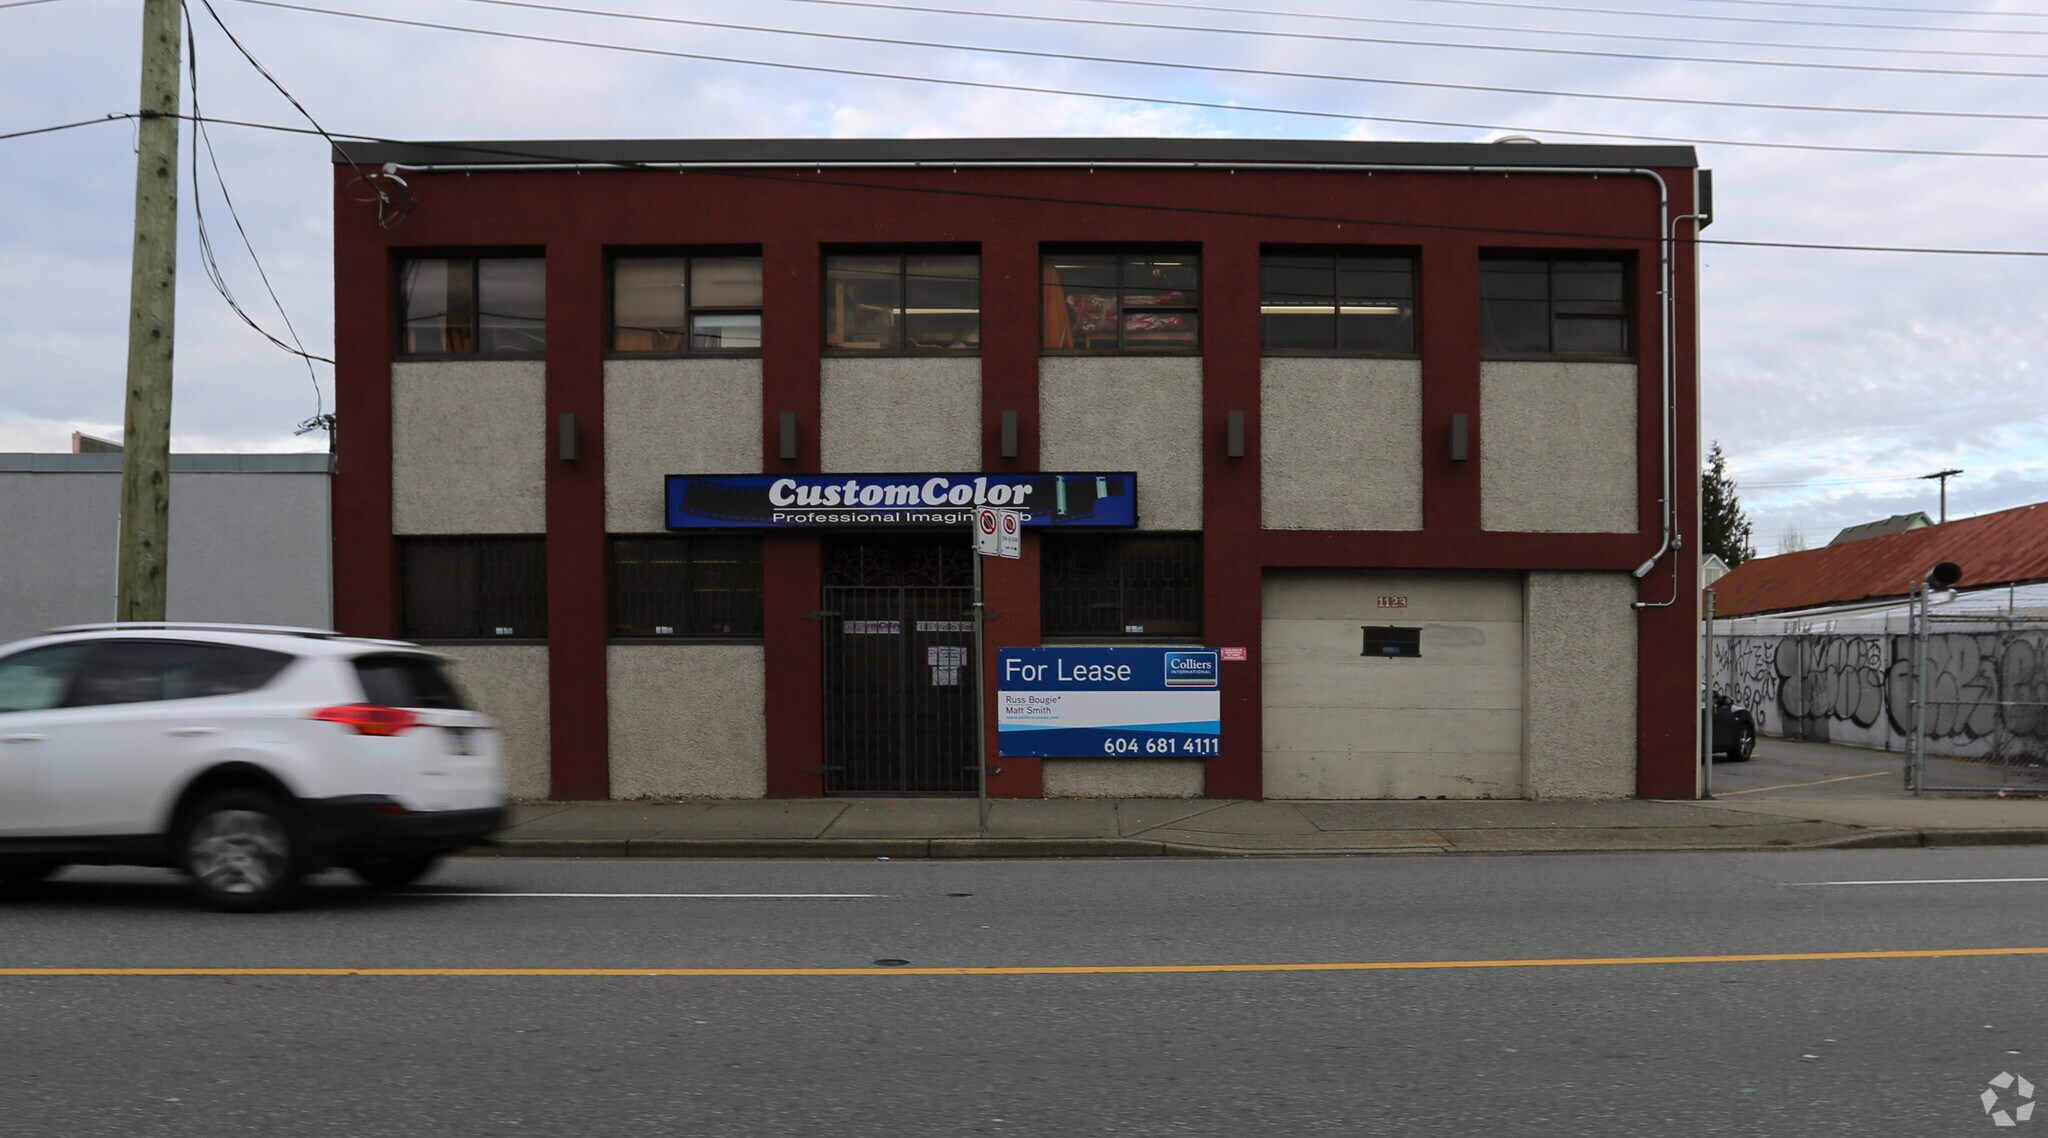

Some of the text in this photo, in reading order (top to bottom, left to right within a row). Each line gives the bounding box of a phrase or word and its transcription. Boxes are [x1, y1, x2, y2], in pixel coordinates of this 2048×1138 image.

[769, 477, 1033, 507] CustomColor
[773, 512, 974, 524] Professional Imagin
[1377, 597, 1407, 608] 1123
[1170, 658, 1212, 669] Colliers
[1006, 658, 1131, 681] For Lease
[1005, 695, 1027, 704] Russ
[1005, 706, 1052, 715] Matt Smith
[1104, 738, 1219, 753] 604 681 4111
